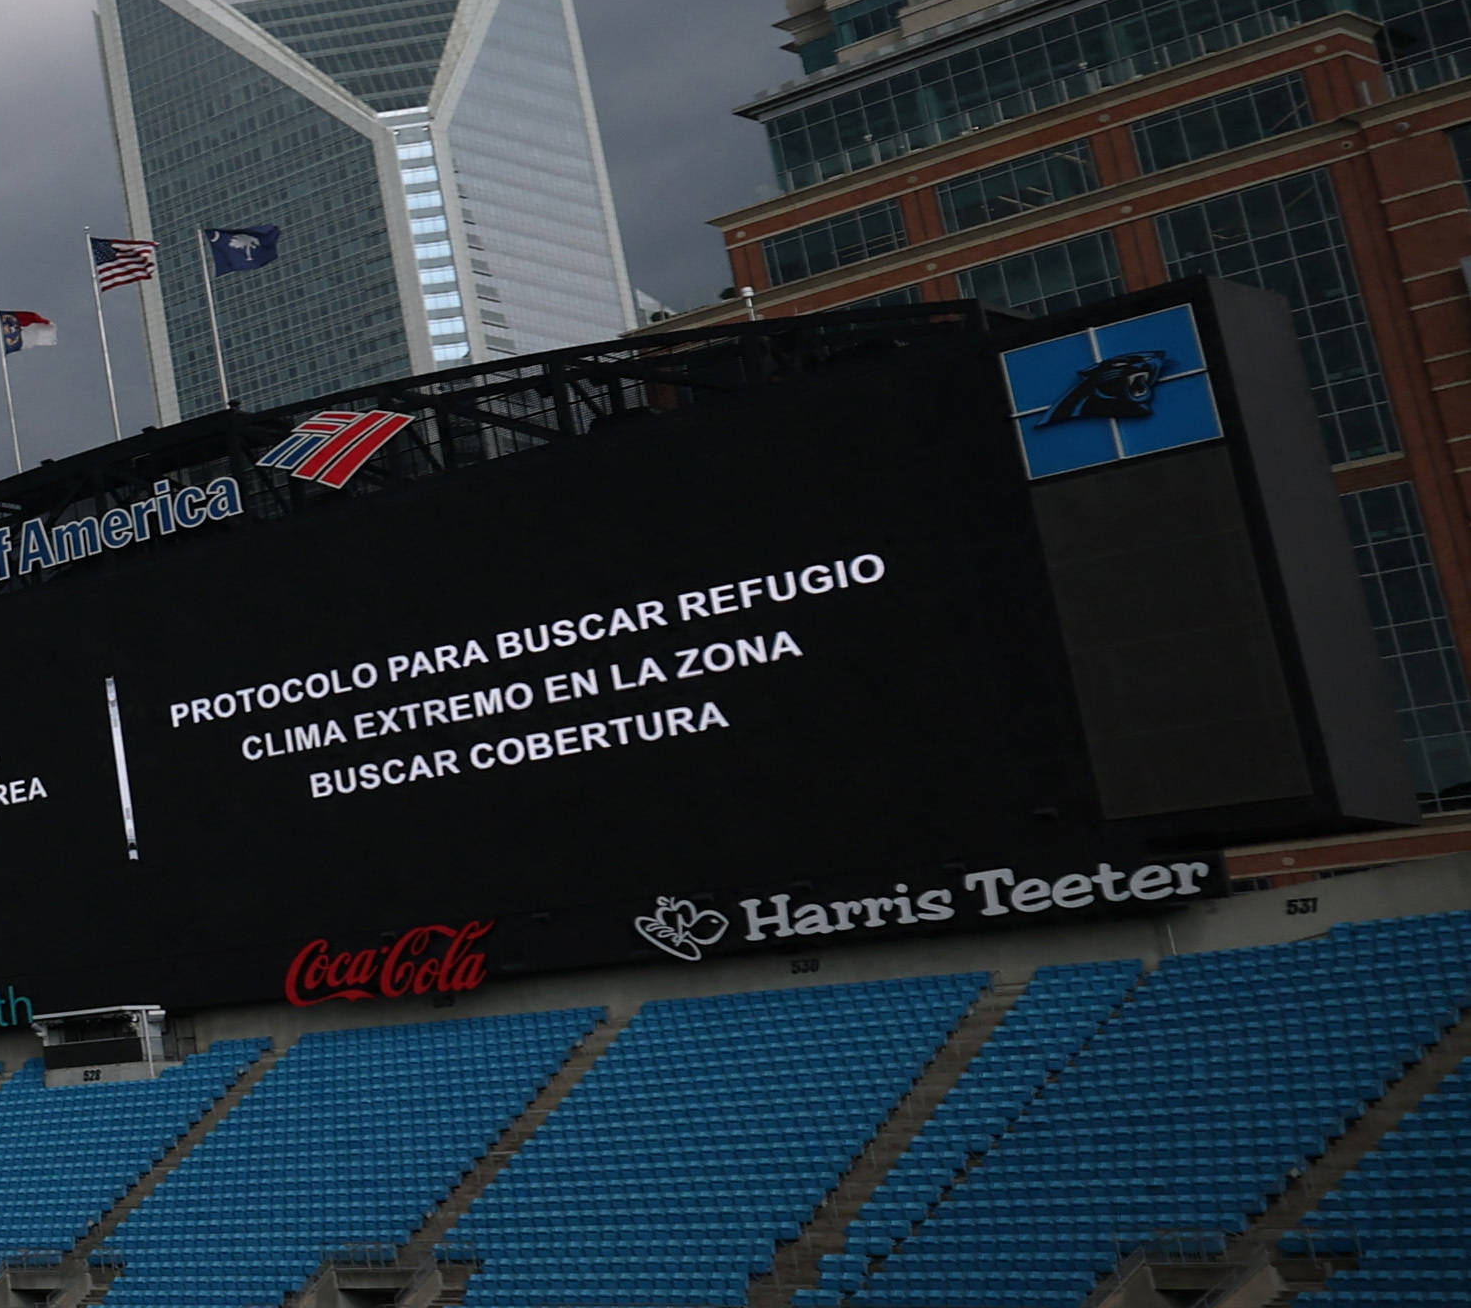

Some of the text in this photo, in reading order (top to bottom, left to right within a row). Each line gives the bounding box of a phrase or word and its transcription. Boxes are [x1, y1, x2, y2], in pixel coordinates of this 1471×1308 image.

[17, 476, 245, 576] America
[170, 554, 885, 728] PROTOCOLO PARA BUSCAR REFUGIO
[242, 631, 803, 761] CLIMA EXTREMO EN LA ZONA
[309, 701, 730, 798] BUSCAR COBERTURA
[738, 884, 956, 942] Harris
[963, 860, 1211, 917] Teeter
[1286, 896, 1319, 916] 531
[284, 919, 497, 1008] Coca-Cola
[83, 1069, 102, 1081] 528
